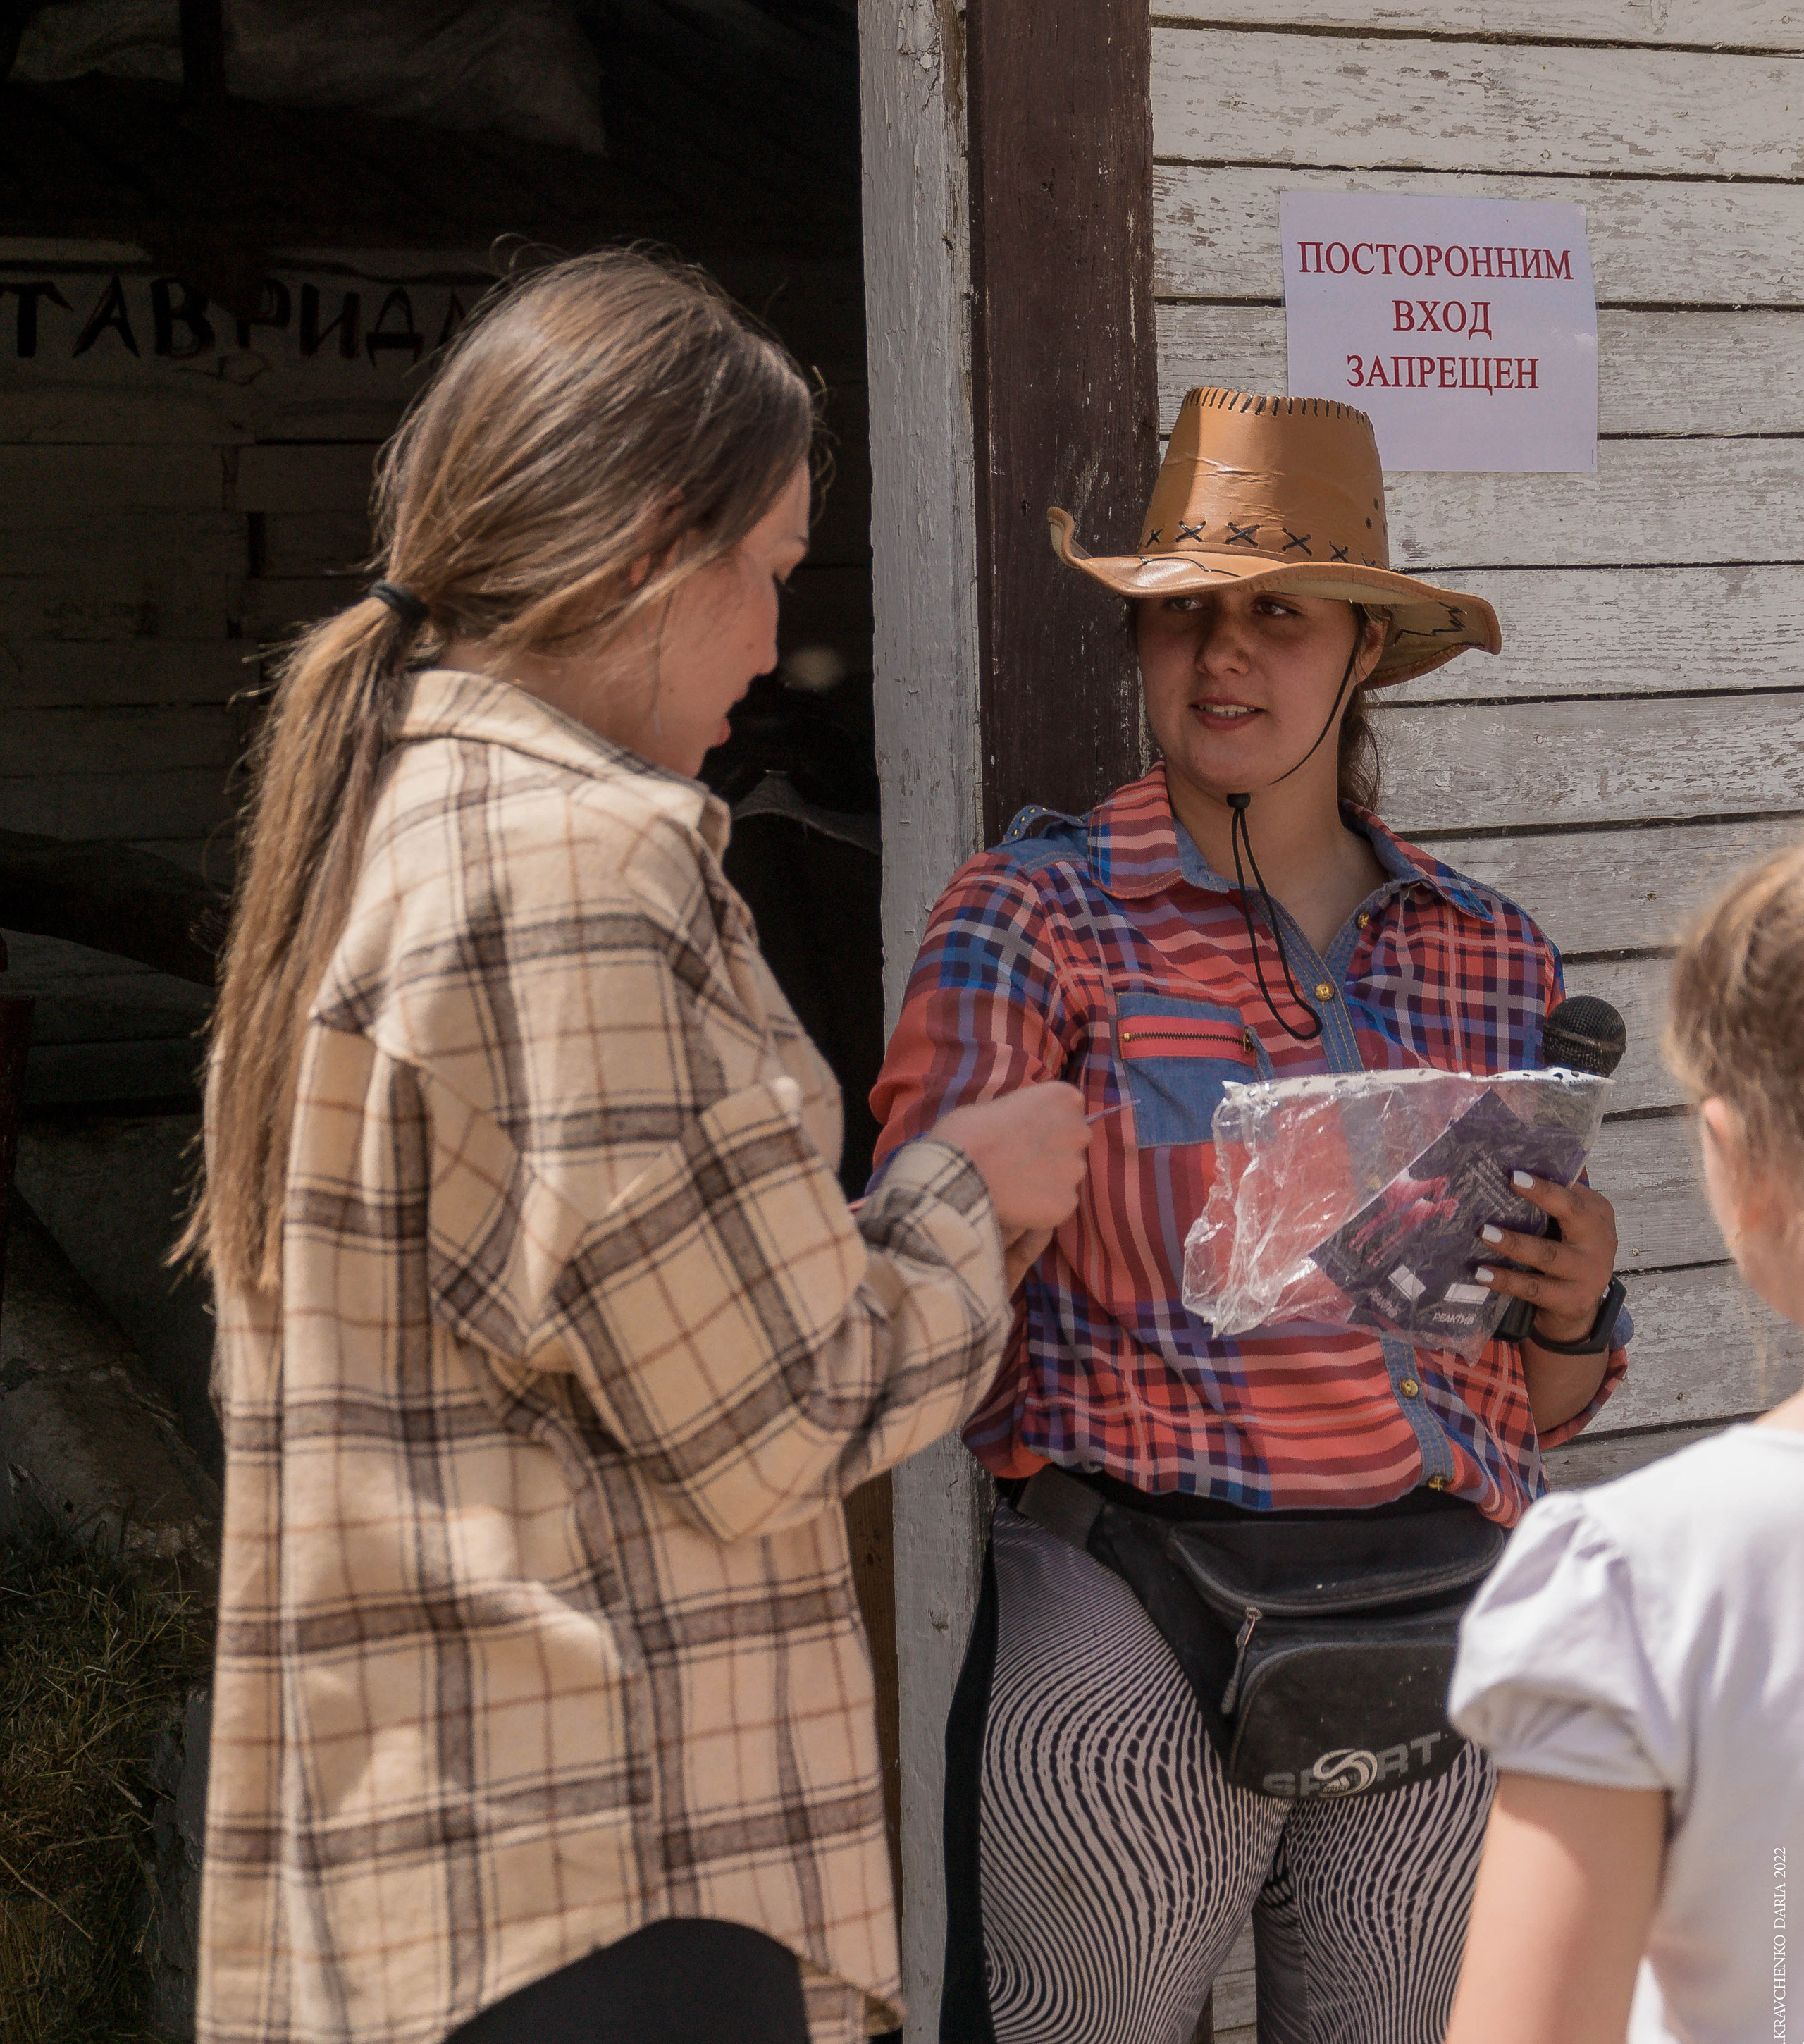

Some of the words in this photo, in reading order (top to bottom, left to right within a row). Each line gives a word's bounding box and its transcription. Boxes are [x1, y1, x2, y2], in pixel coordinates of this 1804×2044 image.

[1297, 242, 1574, 280] ПОСТОРОННИМ
[1392, 300, 1492, 341] ВХОД
[1347, 355, 1540, 396] ЗАПРЕЩЕН
